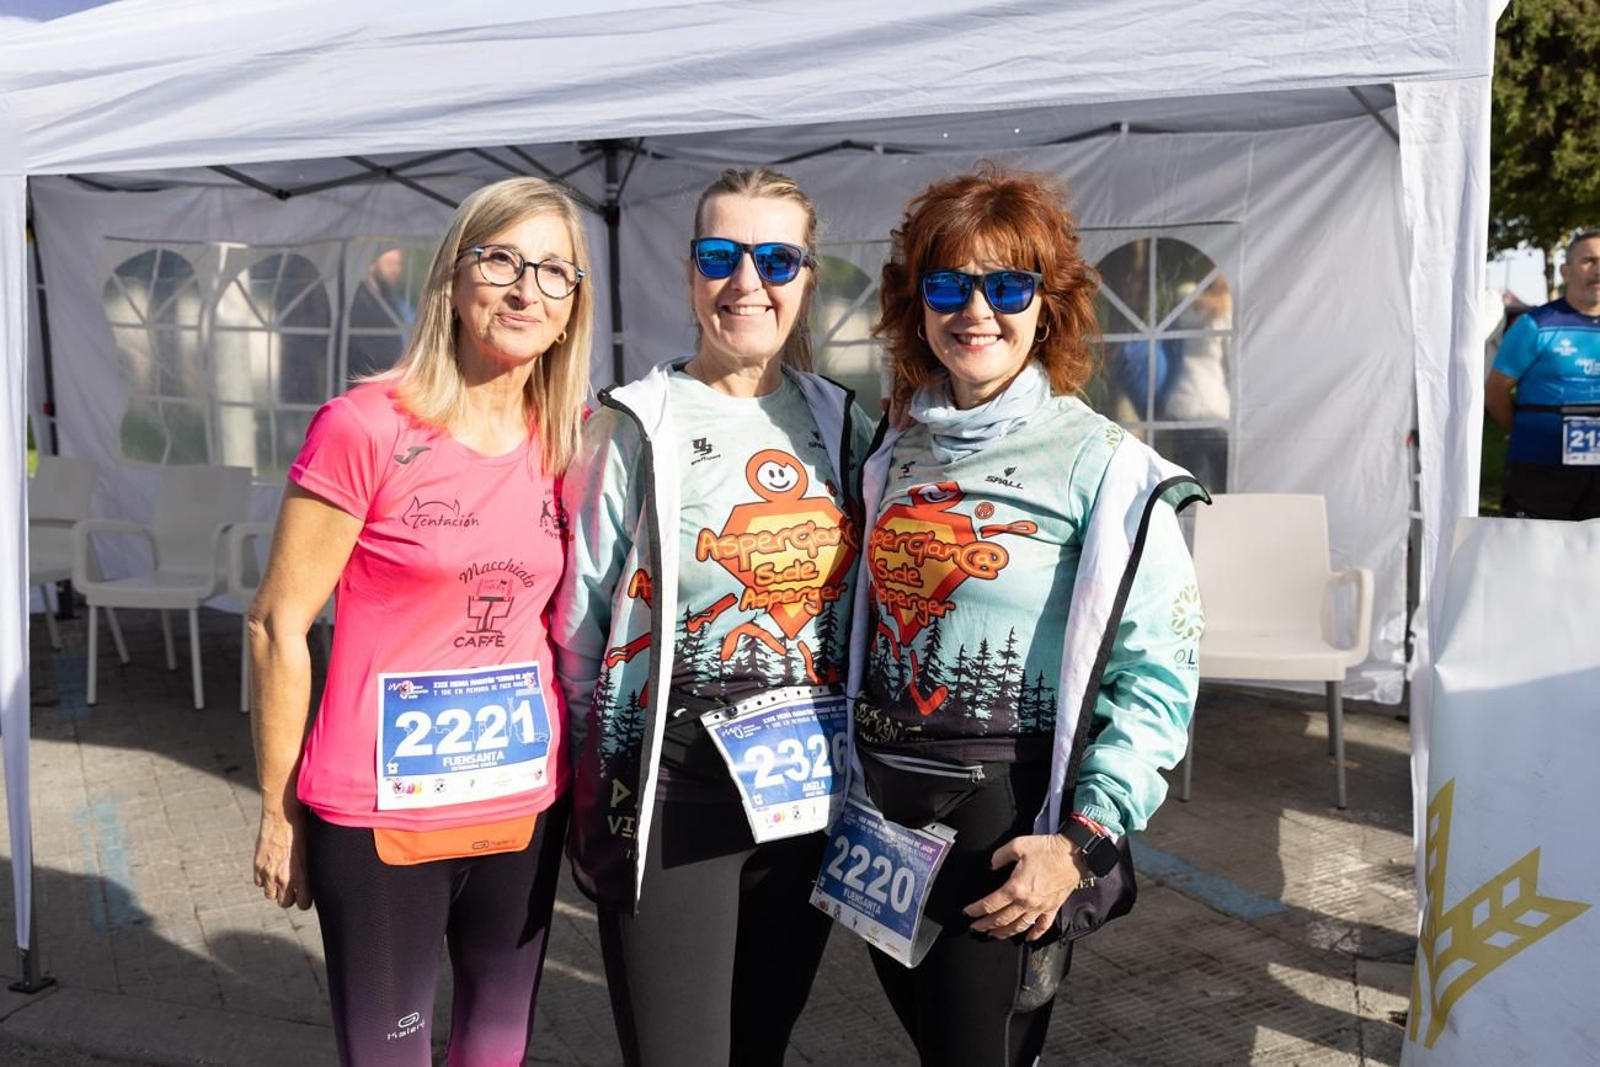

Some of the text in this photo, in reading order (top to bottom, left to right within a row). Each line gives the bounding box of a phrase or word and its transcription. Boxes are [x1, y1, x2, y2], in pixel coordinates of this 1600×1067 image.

[1570, 429, 1600, 448] 21
[409, 512, 480, 530] Tentación
[458, 557, 537, 588] Macchiato
[738, 583, 848, 616] Asperger
[878, 587, 957, 628] sperger
[395, 700, 535, 758] 2221
[443, 750, 505, 767] FUENSANTA
[827, 835, 915, 914] 2220
